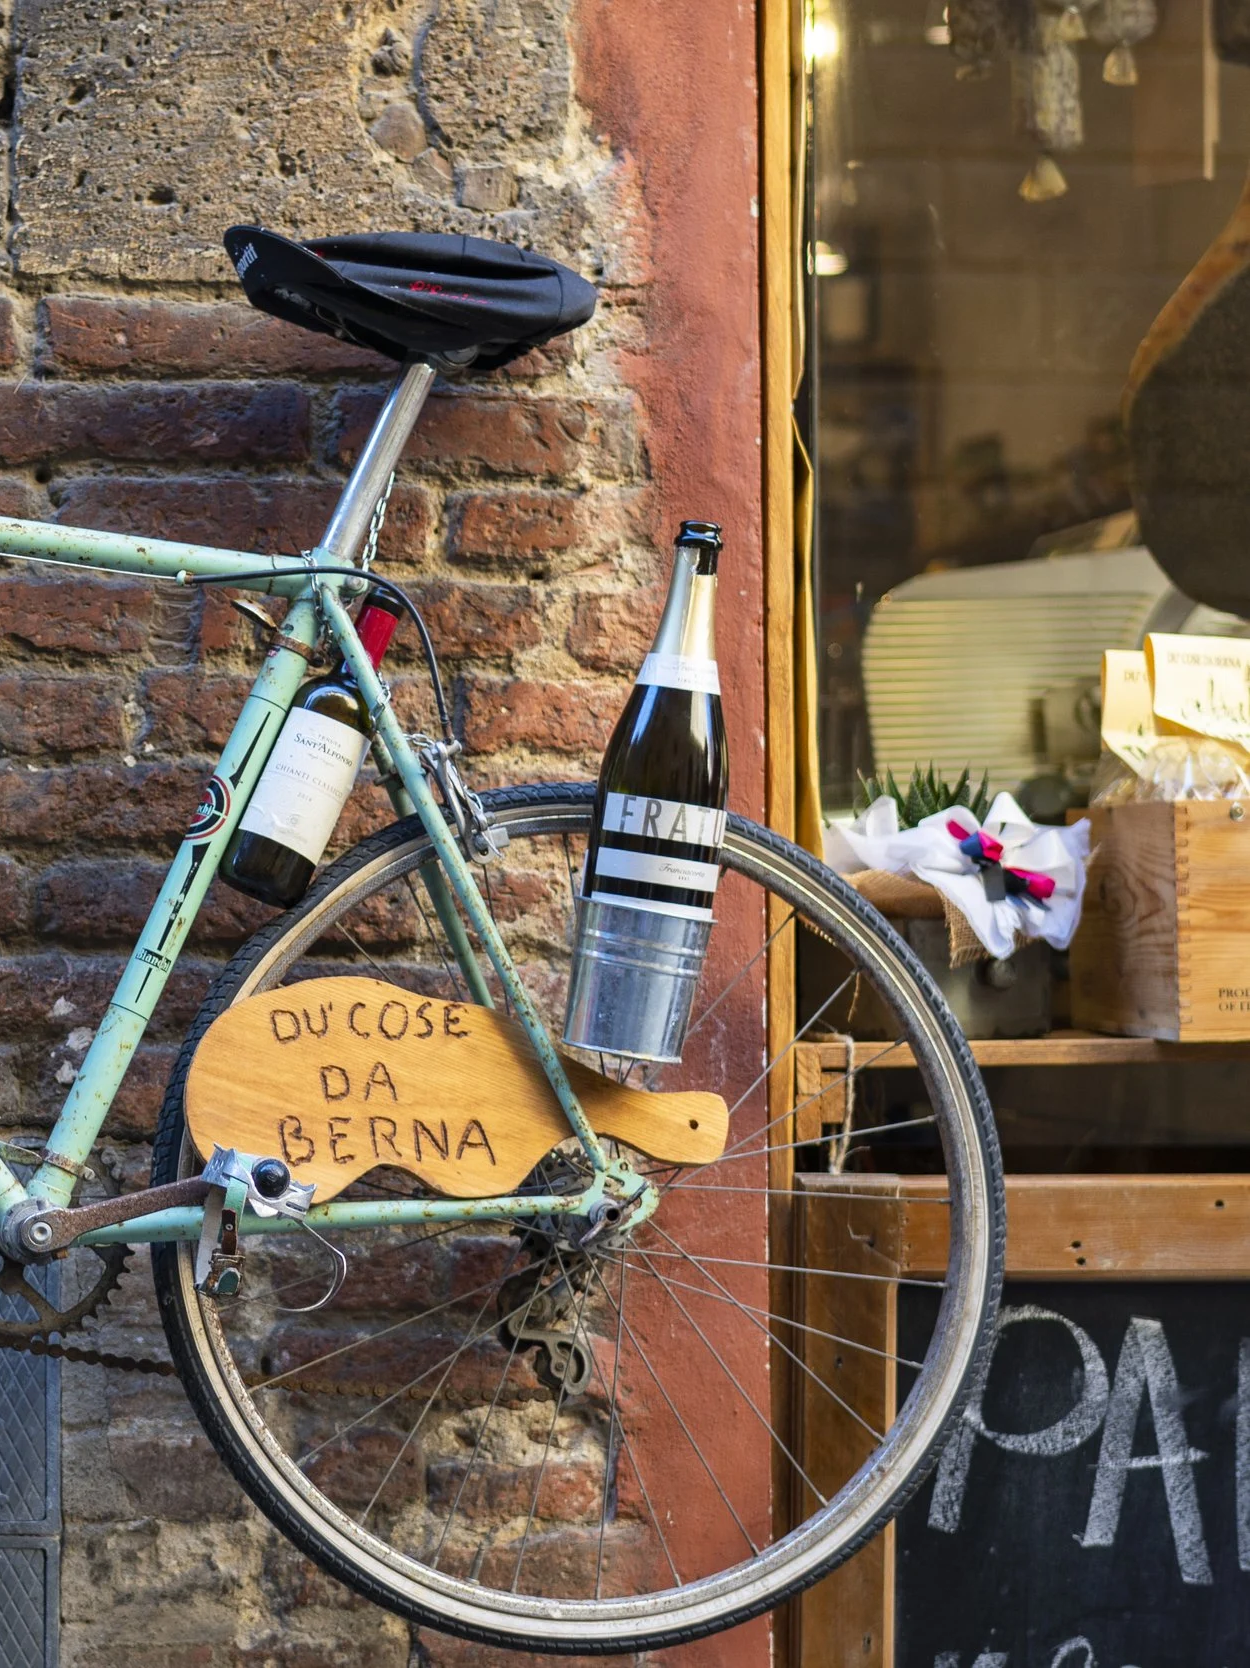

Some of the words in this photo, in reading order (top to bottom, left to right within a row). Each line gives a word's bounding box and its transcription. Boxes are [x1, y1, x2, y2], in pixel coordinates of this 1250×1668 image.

[348, 1000, 471, 1040] COSE
[319, 1061, 398, 1104] DA
[277, 1115, 497, 1167] BERNA
[928, 1304, 1250, 1586] PA
